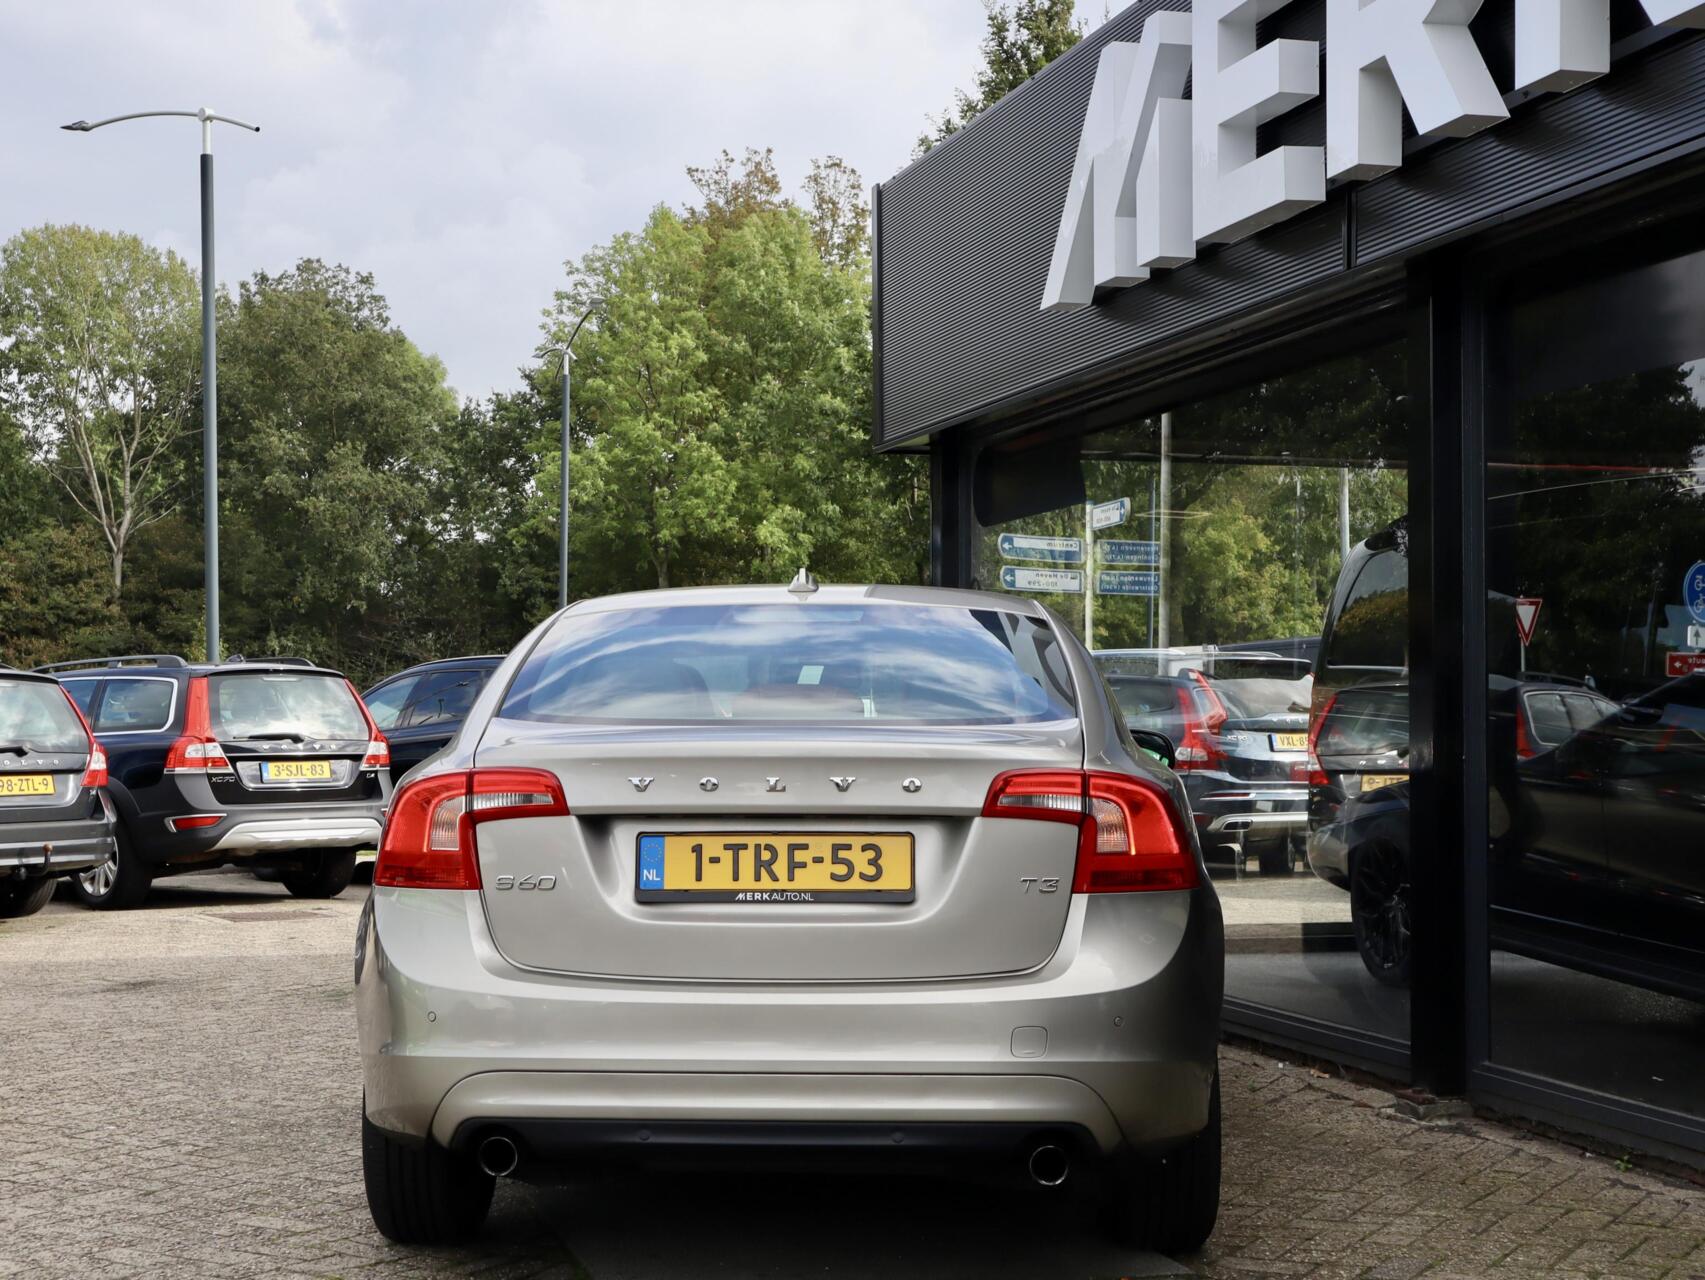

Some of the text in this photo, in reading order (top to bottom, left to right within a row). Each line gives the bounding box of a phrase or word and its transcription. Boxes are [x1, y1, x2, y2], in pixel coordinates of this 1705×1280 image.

[1041, 0, 1705, 312] MER
[274, 764, 324, 777] 3-SJL-83
[0, 778, 48, 792] 98-ZTL-9
[628, 776, 925, 793] VOLVO
[691, 843, 883, 882] 1-TRF-53
[495, 874, 557, 890] S60
[642, 870, 661, 881] NL
[1020, 877, 1060, 893] T3
[735, 892, 814, 901] MERKAUTO.NL
